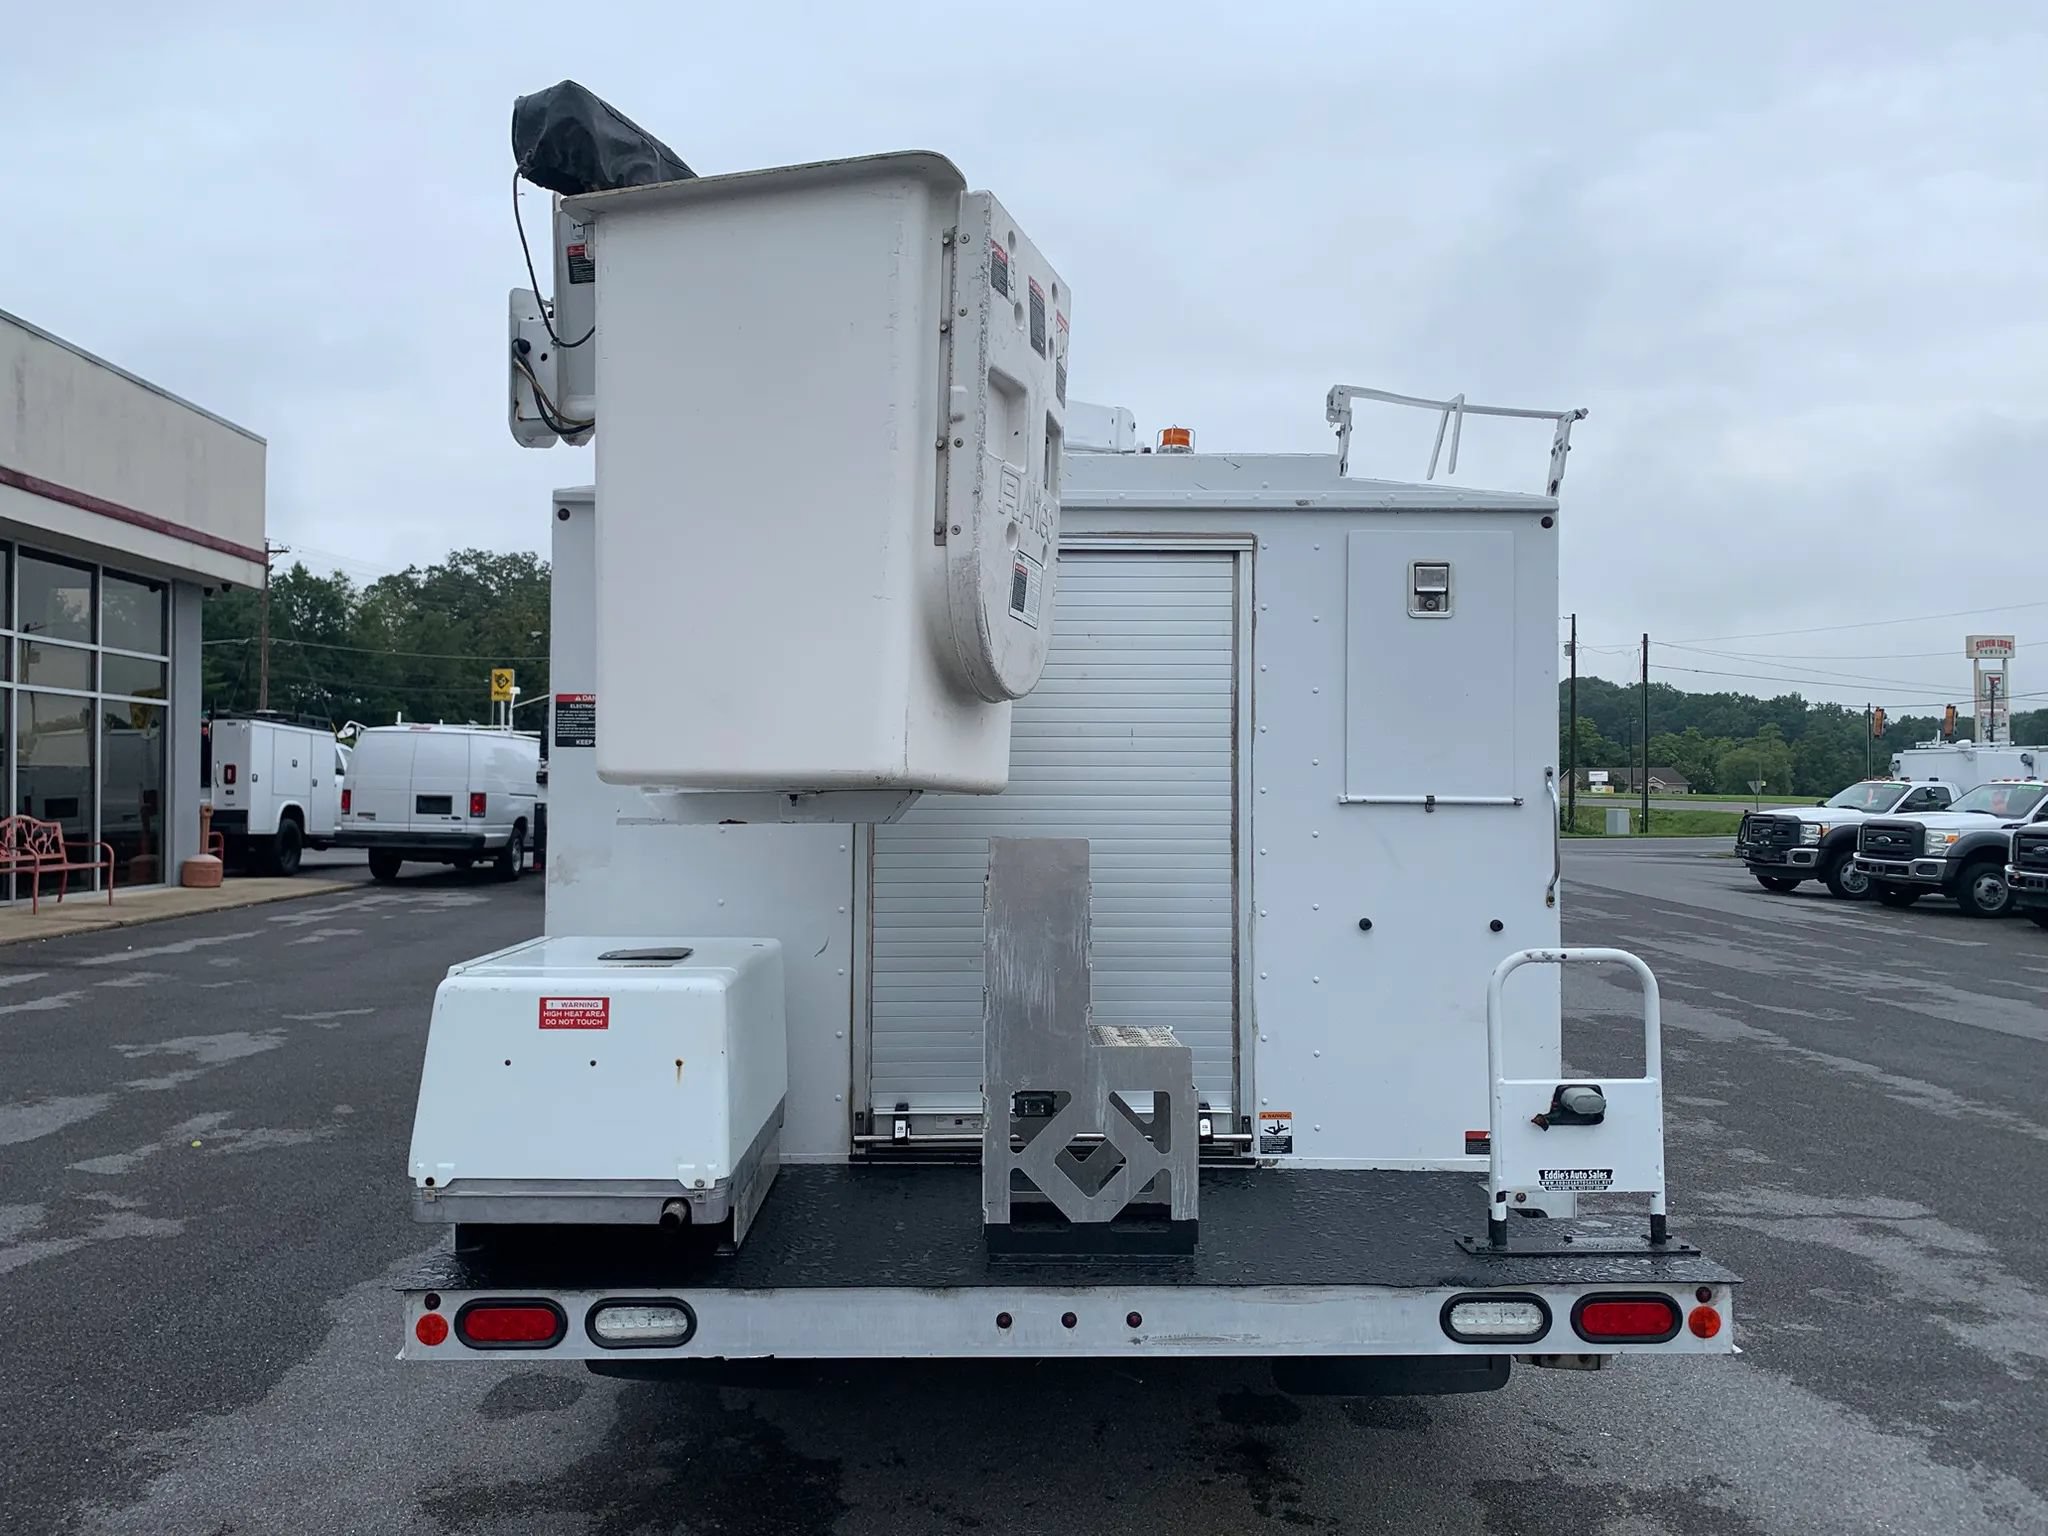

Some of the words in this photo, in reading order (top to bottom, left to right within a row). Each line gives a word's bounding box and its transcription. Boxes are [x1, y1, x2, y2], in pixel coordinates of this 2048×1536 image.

[545, 1018, 557, 1026] DO
[558, 1018, 575, 1026] NOT
[577, 1018, 603, 1026] TOUCH
[1544, 1170, 1569, 1180] Eddie's
[1570, 1170, 1588, 1179] Auto
[1588, 1169, 1608, 1179] Sales
